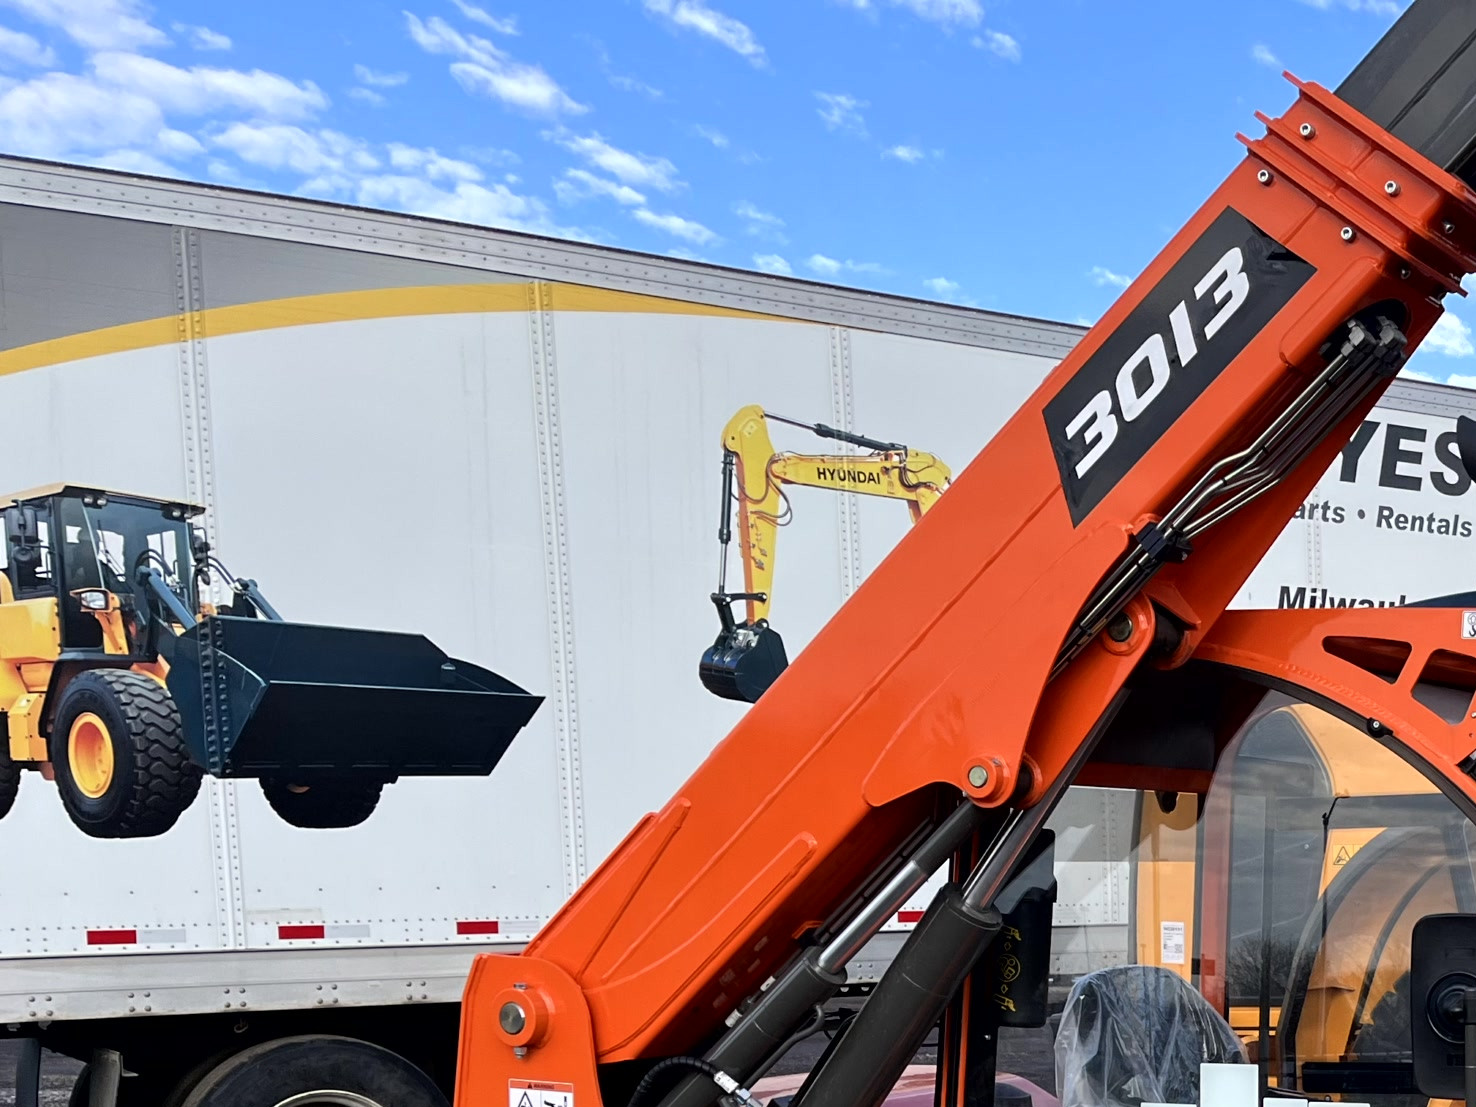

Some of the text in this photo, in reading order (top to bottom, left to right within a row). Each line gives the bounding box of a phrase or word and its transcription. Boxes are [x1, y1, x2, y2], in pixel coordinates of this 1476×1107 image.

[1065, 247, 1249, 479] 3013
[816, 467, 881, 485] HYUNDAI
[1293, 500, 1346, 524] arts
[1376, 505, 1473, 537] Rentals
